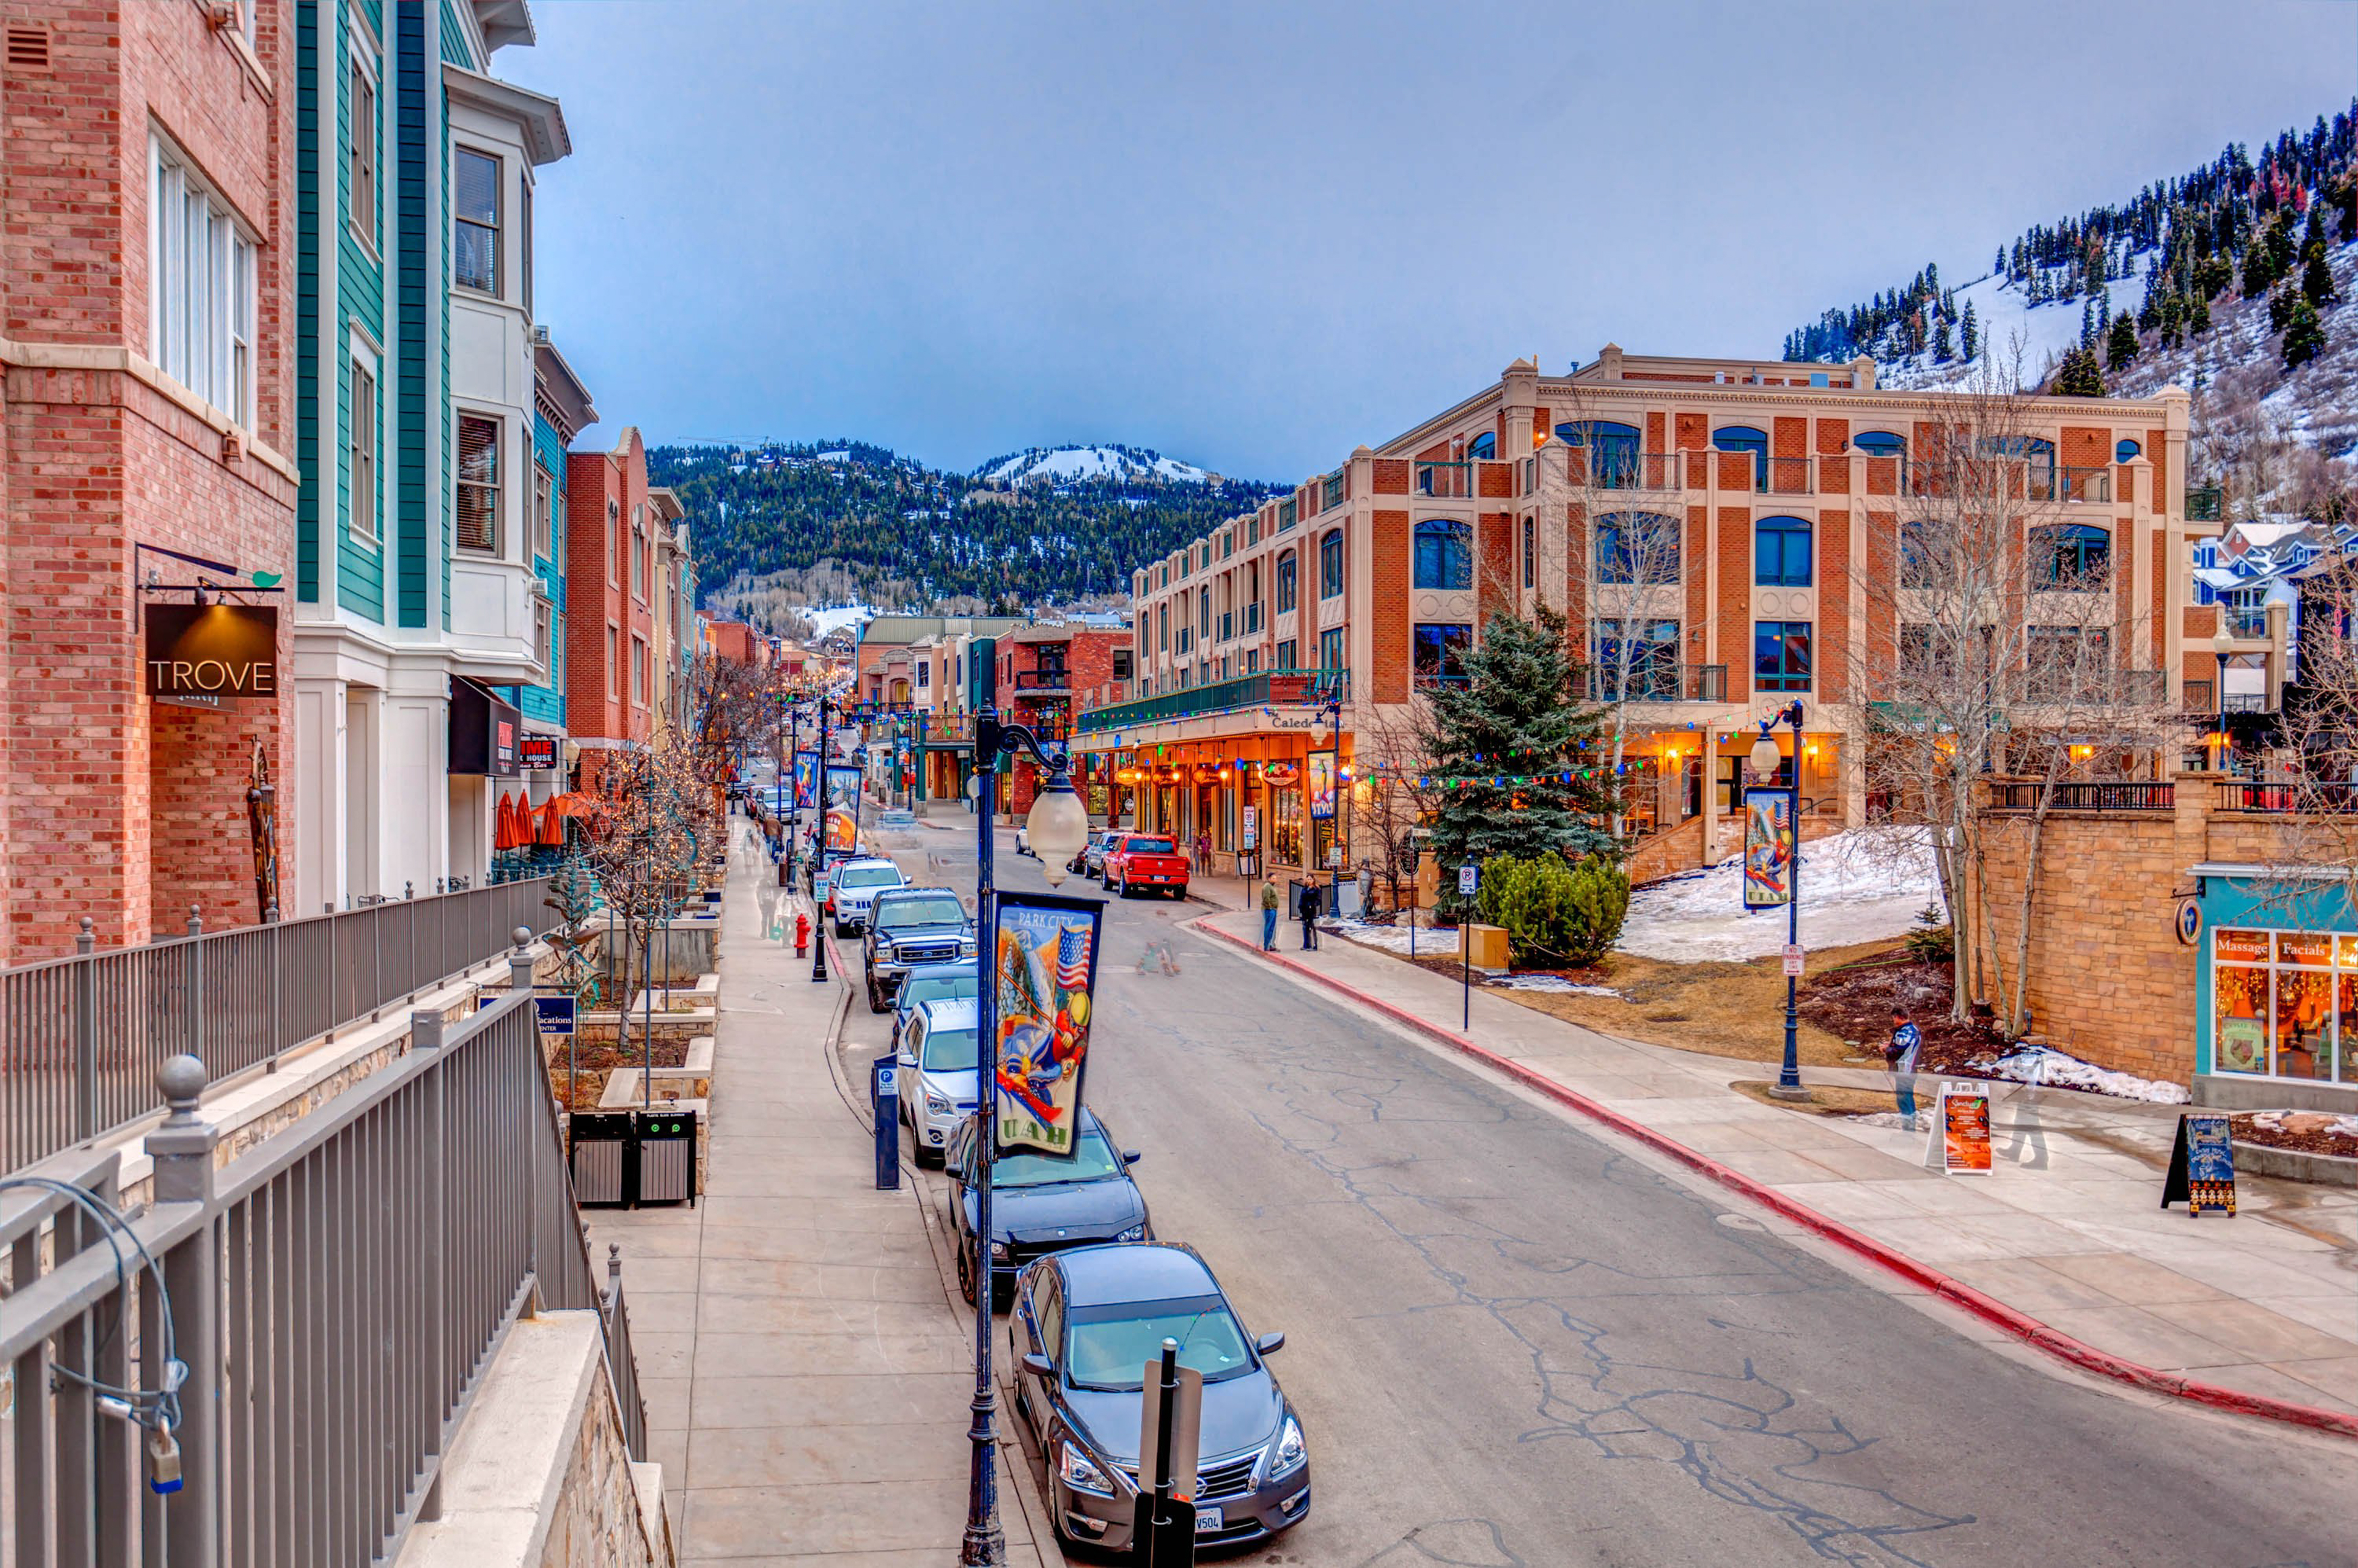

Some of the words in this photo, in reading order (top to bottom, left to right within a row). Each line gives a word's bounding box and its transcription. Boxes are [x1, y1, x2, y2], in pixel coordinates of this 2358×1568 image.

[149, 660, 273, 690] TROVE
[520, 741, 552, 755] IME
[797, 753, 817, 763] UTAH
[826, 830, 854, 849] UTAH
[1748, 891, 1787, 901] UTAH
[1018, 912, 1046, 928] PARK
[1048, 915, 1075, 929] CITY
[2218, 939, 2268, 956] Massage
[2282, 942, 2325, 956] Facials
[1197, 1517, 1219, 1529] V504
